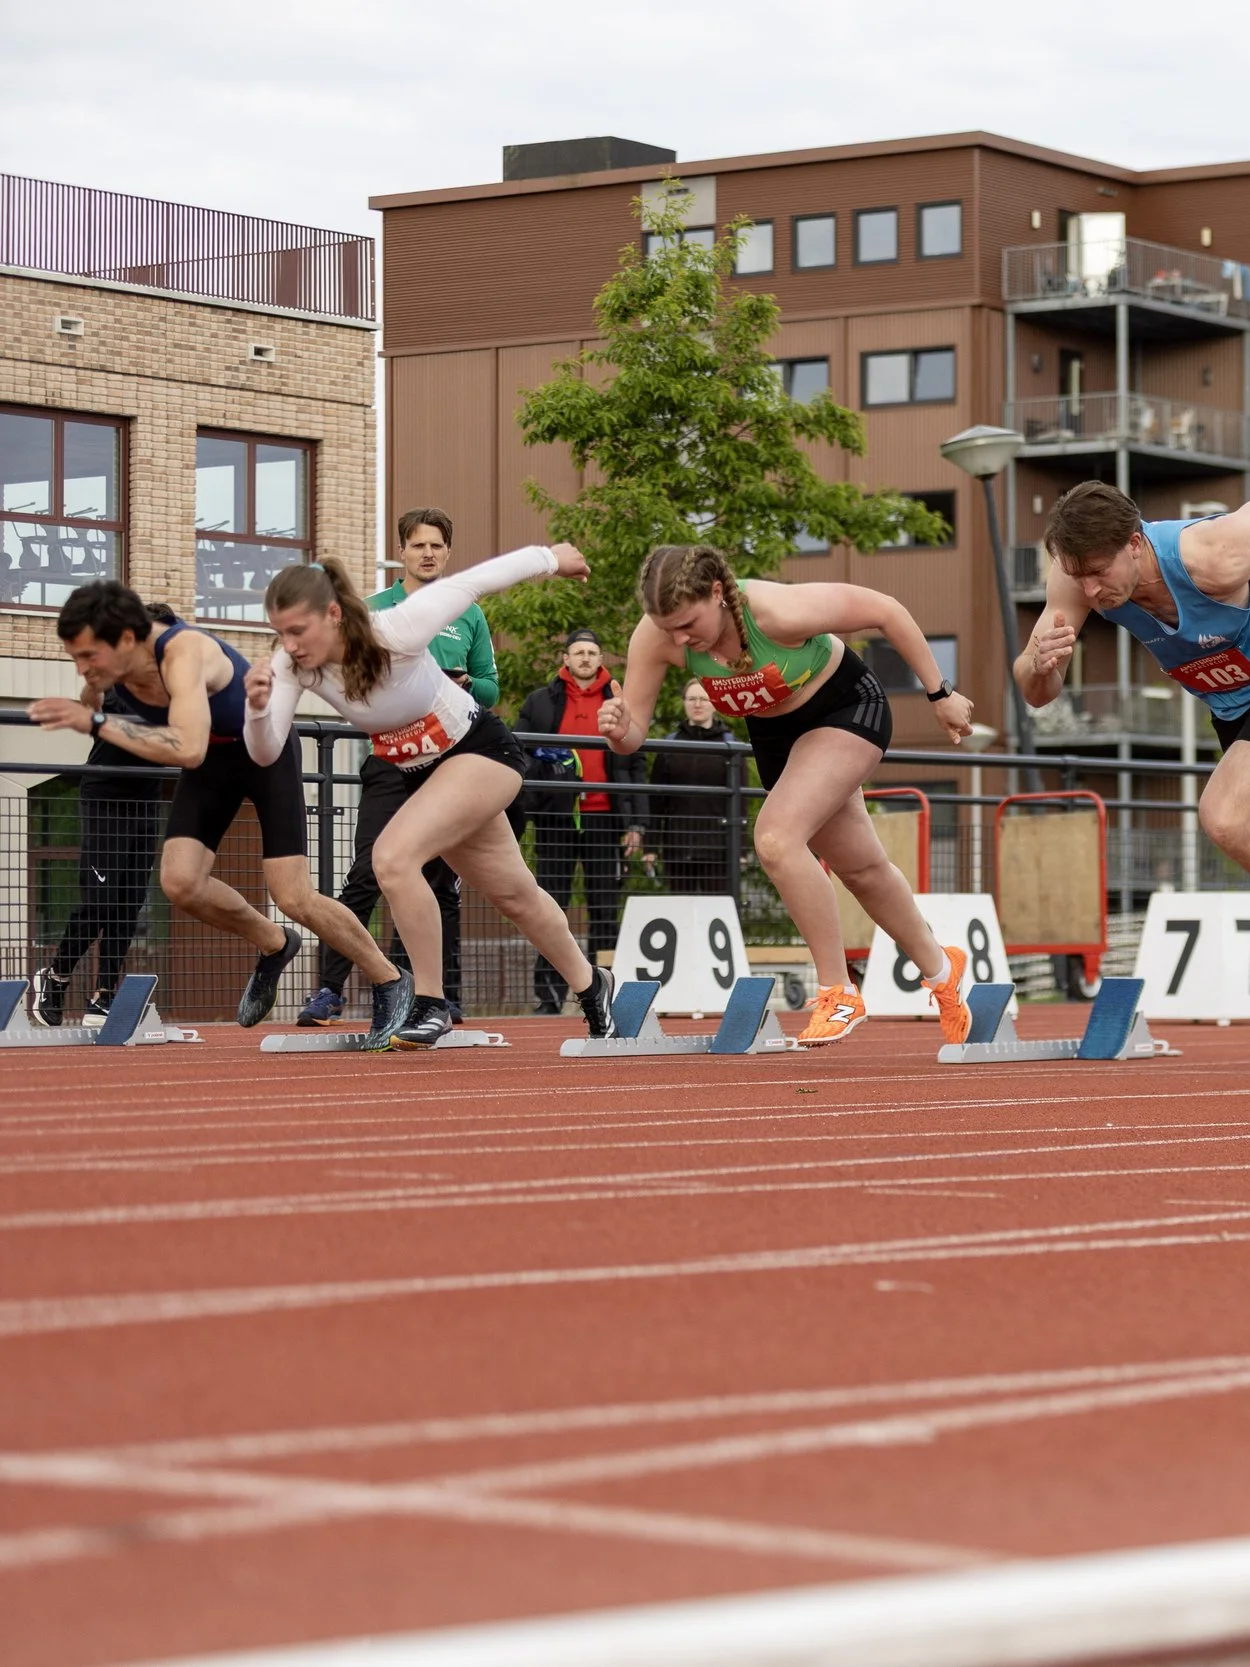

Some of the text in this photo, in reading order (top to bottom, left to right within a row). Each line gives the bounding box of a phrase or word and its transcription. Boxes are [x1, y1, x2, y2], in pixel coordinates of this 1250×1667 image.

[712, 671, 765, 687] AMSTERDAMS
[1180, 652, 1229, 673] AMSTERDAMS
[1195, 664, 1250, 688] 103
[720, 686, 775, 712] 121
[636, 917, 677, 988] 9
[708, 917, 735, 990] 9
[967, 917, 994, 984] 8
[1166, 919, 1201, 995] 7
